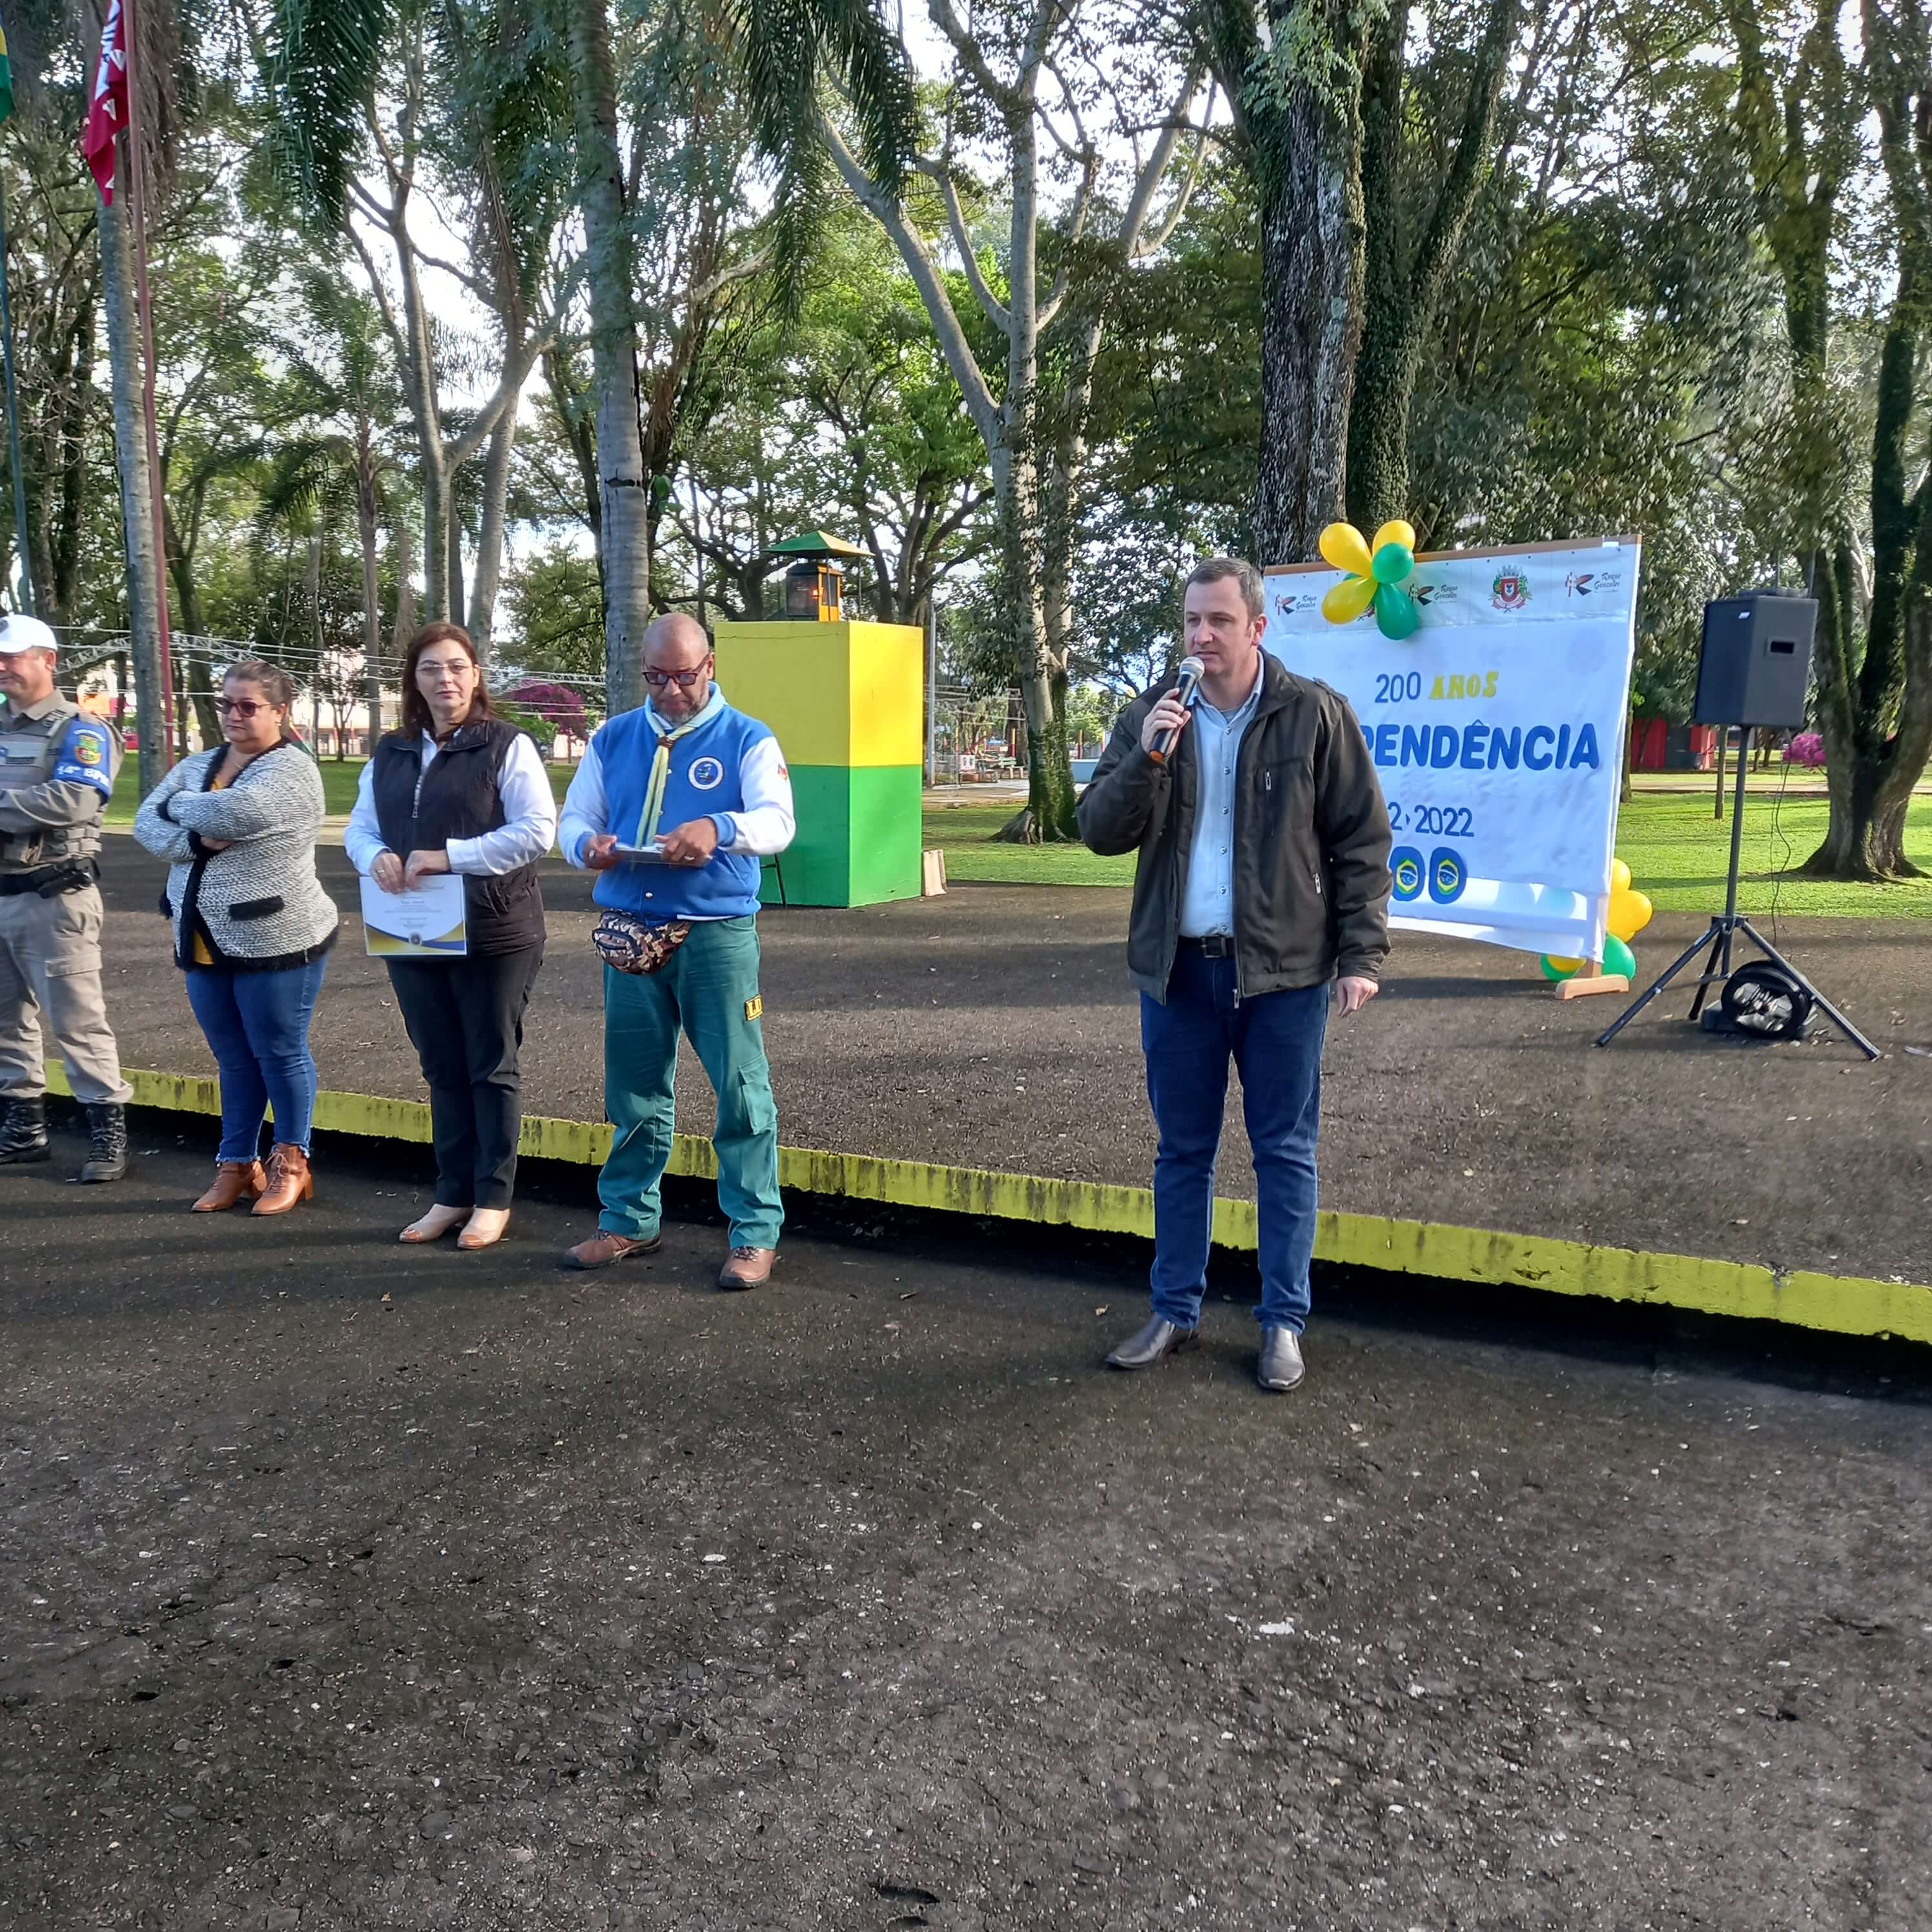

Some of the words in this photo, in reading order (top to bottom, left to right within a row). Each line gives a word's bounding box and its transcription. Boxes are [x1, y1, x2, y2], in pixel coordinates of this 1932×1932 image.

[1375, 671, 1421, 703] 200
[1430, 671, 1499, 700] ANOS
[1414, 805, 1474, 837] 2022
